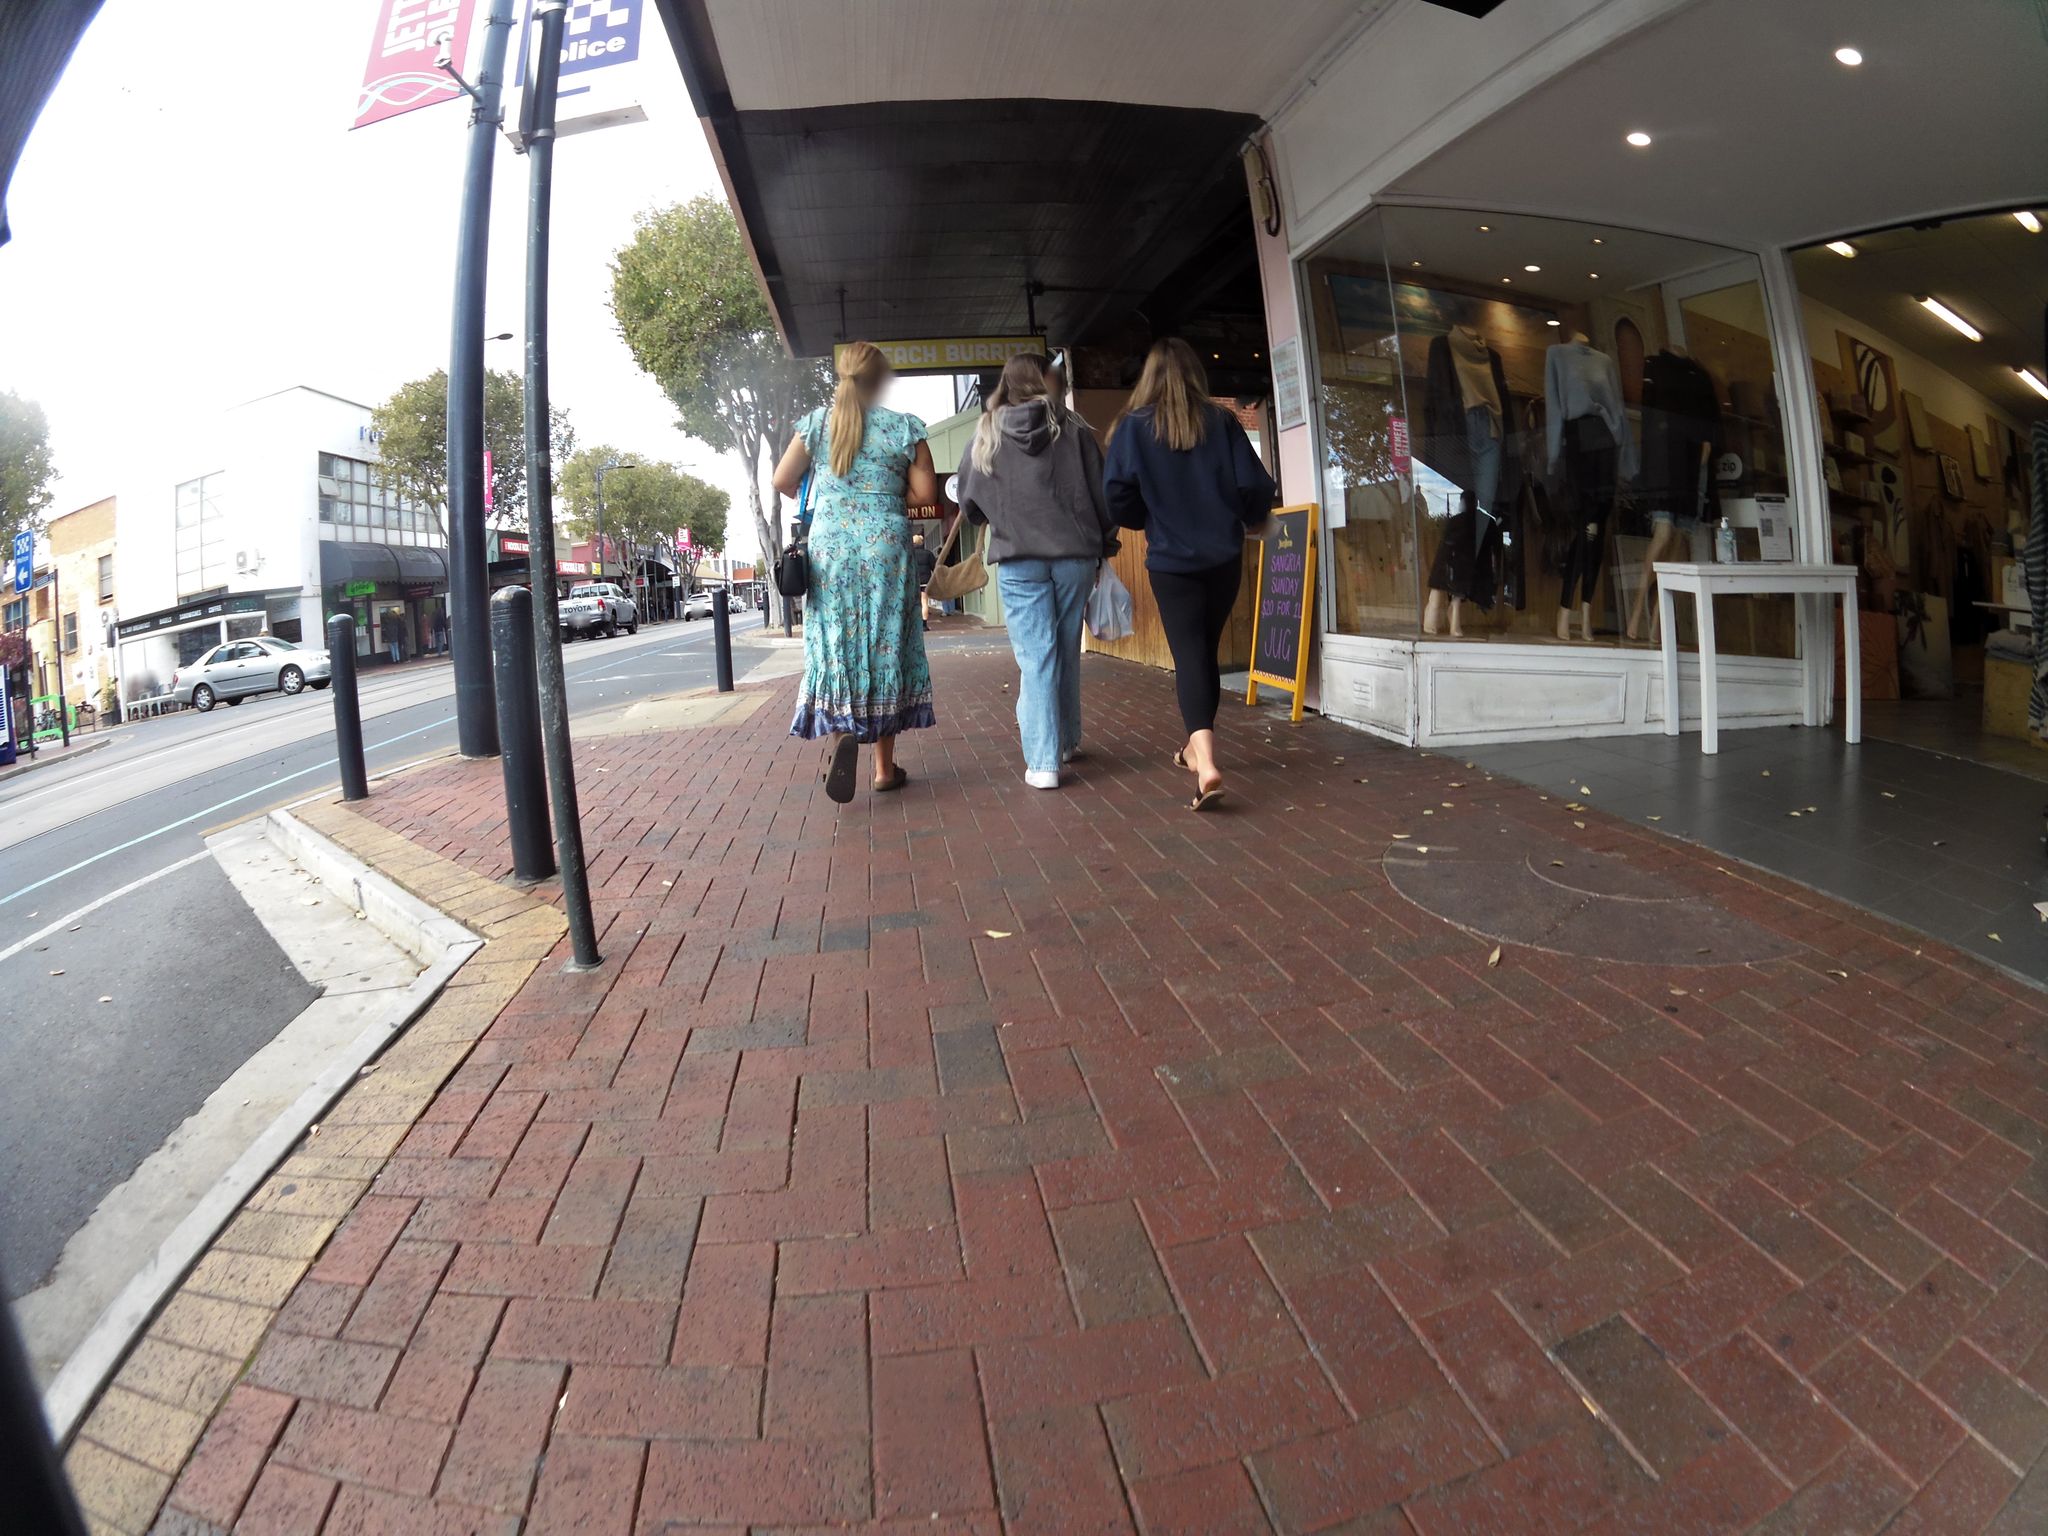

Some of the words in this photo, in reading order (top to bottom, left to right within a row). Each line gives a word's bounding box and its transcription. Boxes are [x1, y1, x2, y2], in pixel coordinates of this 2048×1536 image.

[1271, 554, 1301, 573] SANGRIA
[1271, 576, 1298, 597] SUNDAY
[564, 605, 592, 614] TOYOTA
[1276, 601, 1290, 616] FOR
[1264, 628, 1291, 662] JUG
